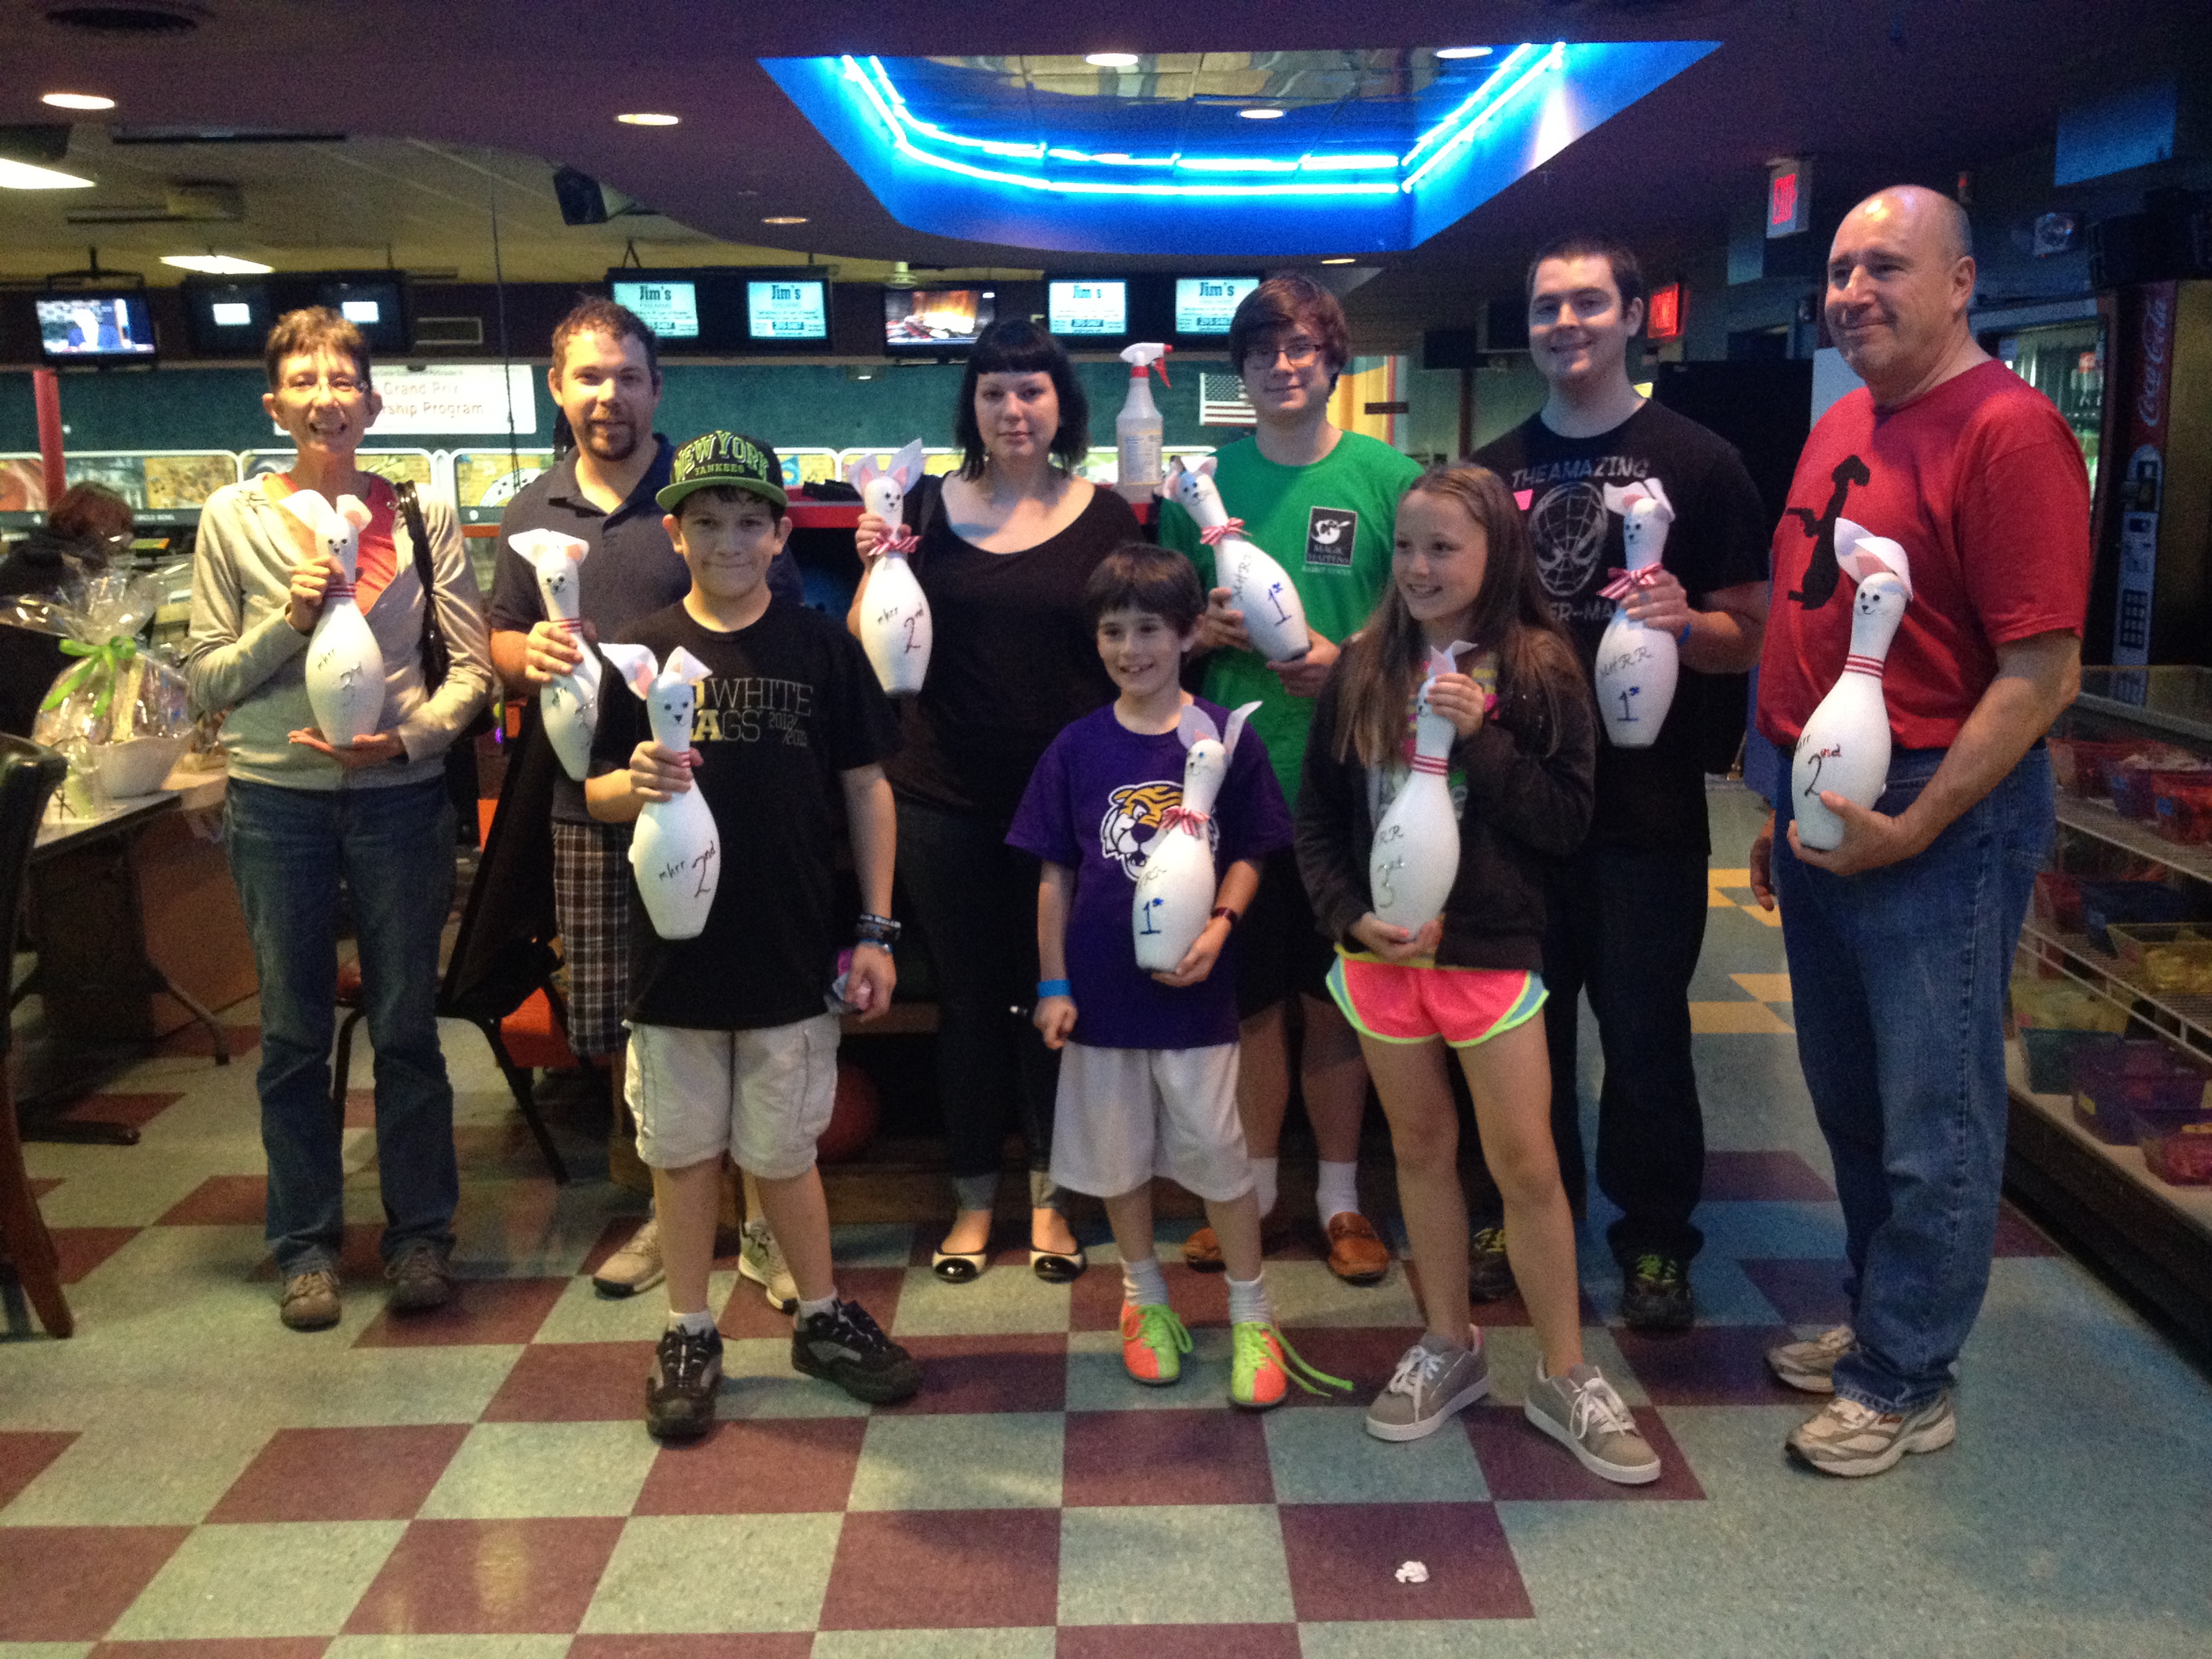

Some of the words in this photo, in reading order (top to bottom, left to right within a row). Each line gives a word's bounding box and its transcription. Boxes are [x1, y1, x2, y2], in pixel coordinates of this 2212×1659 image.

[640, 285, 672, 301] Jim's
[771, 285, 801, 301] Jim's
[1199, 282, 1234, 297] Jim's
[384, 381, 426, 395] Grand
[423, 402, 484, 419] Program
[674, 434, 715, 481] NEW
[714, 430, 769, 482] YORK
[1547, 456, 1650, 480] AMAZING
[705, 676, 813, 717] WHITE
